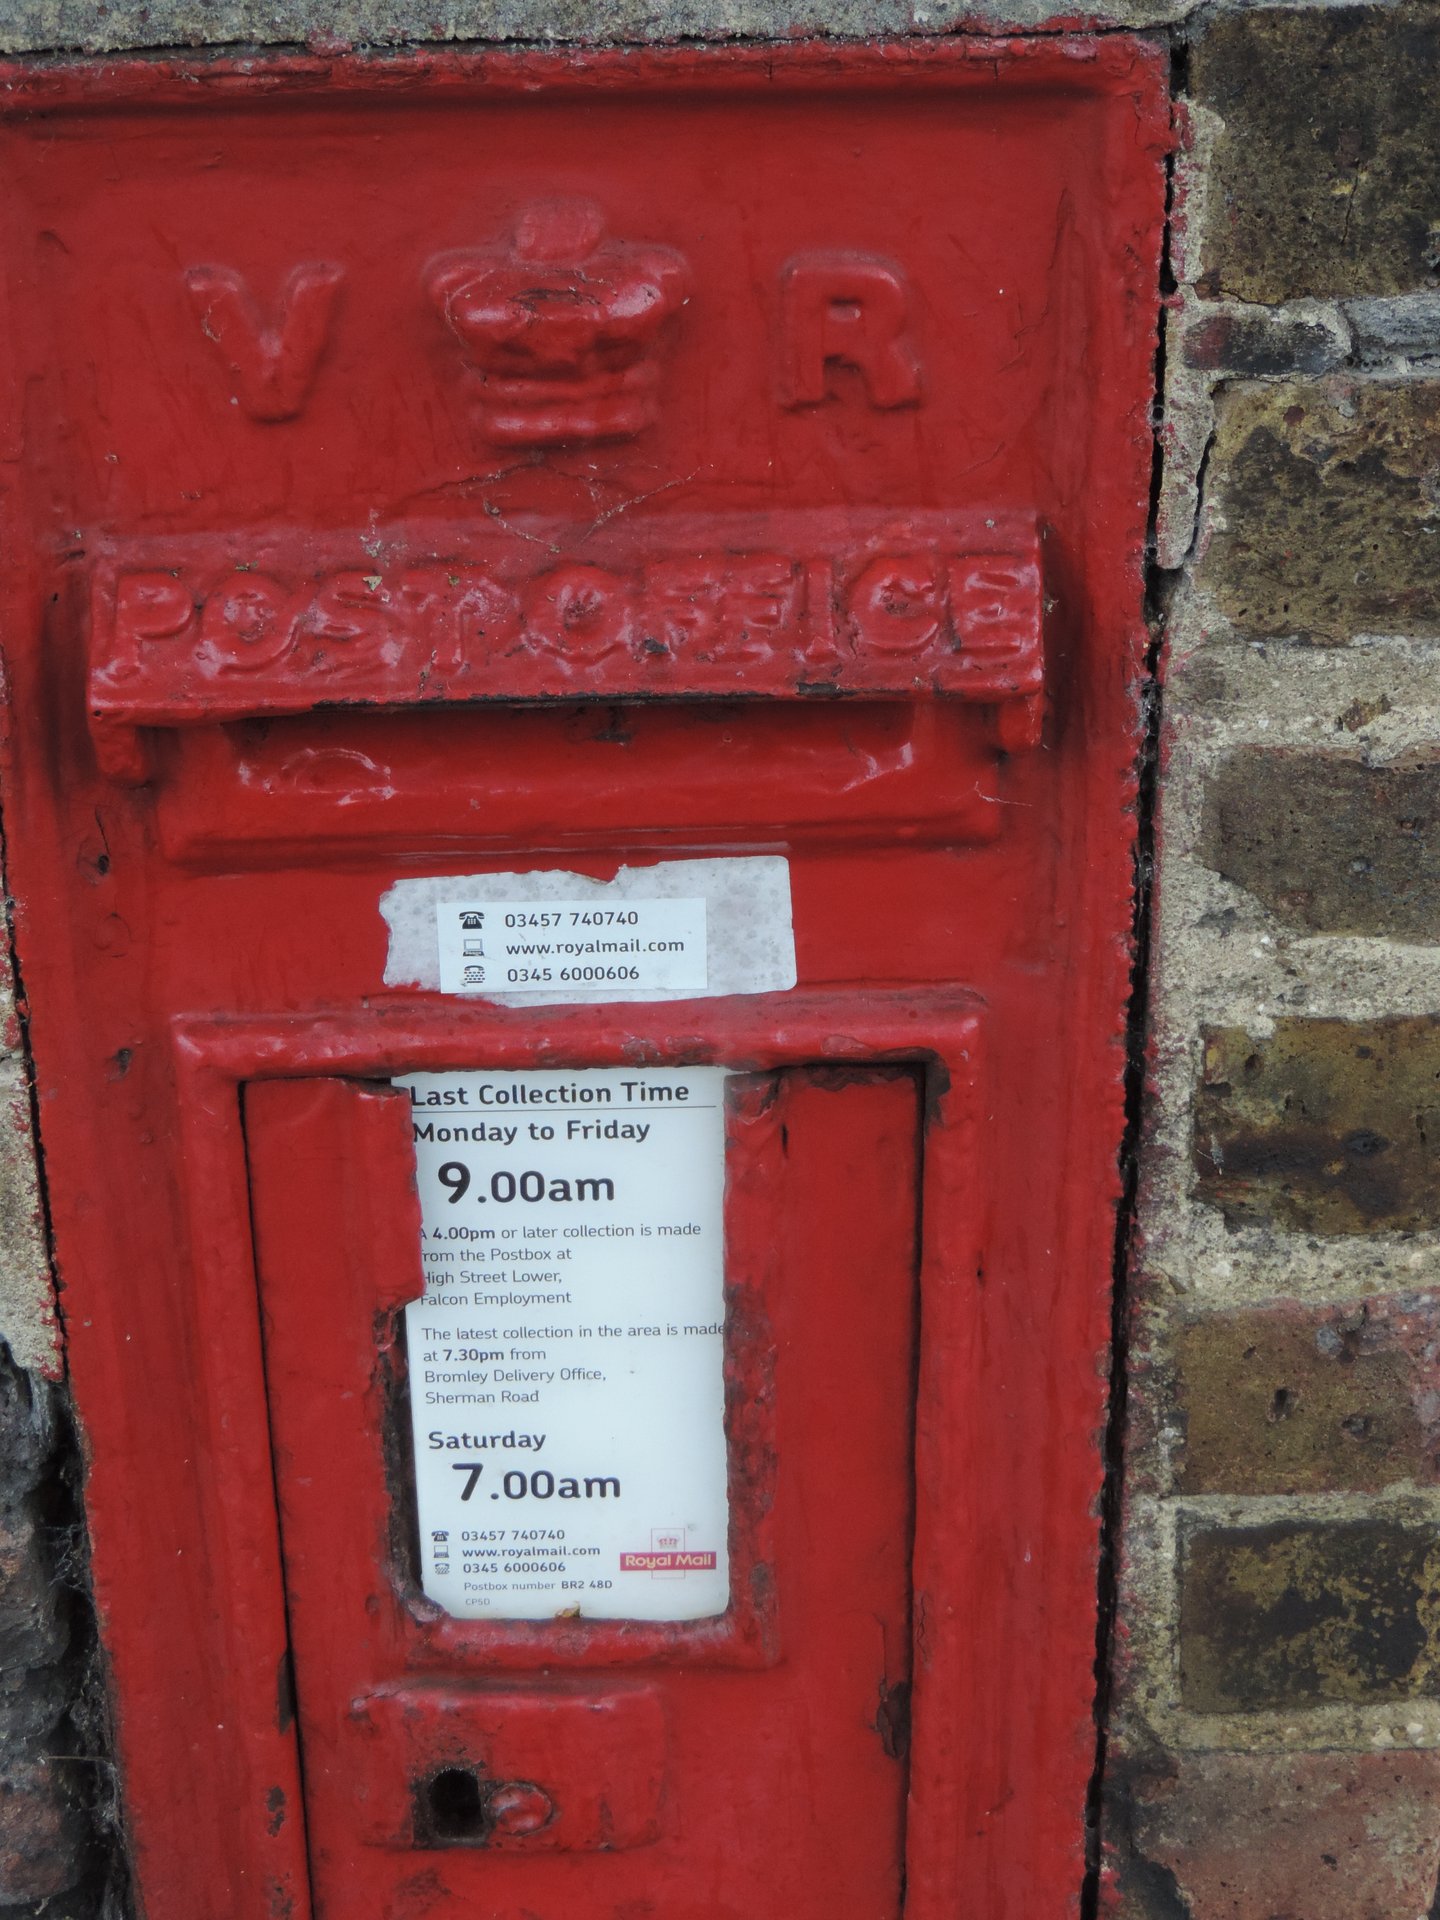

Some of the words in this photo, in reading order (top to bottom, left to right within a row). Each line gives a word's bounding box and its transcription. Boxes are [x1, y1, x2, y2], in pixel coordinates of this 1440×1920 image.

[184, 262, 346, 423] V
[779, 249, 921, 412] R
[504, 913, 561, 928] 03457
[569, 911, 639, 927] 740740
[505, 938, 685, 957] www.royalmail.com
[507, 968, 552, 983] 0345
[560, 966, 640, 981] 6000606
[410, 1085, 469, 1106] Last
[479, 1083, 612, 1105] Collection
[620, 1082, 690, 1102] Time
[412, 1121, 518, 1146] Monday
[528, 1122, 554, 1141] to
[567, 1119, 650, 1143] Friday
[438, 1161, 615, 1204] 9.00am
[432, 1226, 495, 1242] 4.00pm
[501, 1228, 518, 1239] or
[522, 1226, 558, 1239] later
[563, 1224, 635, 1238] collection
[640, 1223, 652, 1237] is
[657, 1222, 702, 1236] made
[460, 1248, 485, 1262] the
[490, 1247, 551, 1261] Postbox
[556, 1248, 572, 1260] at
[460, 1270, 507, 1284] Street
[512, 1269, 562, 1284] Lower,
[420, 1293, 468, 1306] Falcon
[474, 1291, 572, 1307] Employment
[422, 1327, 451, 1341] The
[456, 1326, 498, 1340] latest
[503, 1325, 573, 1339] collection
[578, 1324, 593, 1338] in
[598, 1324, 623, 1337] the
[628, 1326, 661, 1336] area
[666, 1323, 678, 1336] is
[683, 1323, 724, 1335] made
[423, 1351, 439, 1363] at
[442, 1347, 505, 1363] 7.30pm
[510, 1347, 547, 1361] from
[424, 1369, 488, 1385] Bromley
[493, 1368, 555, 1383] Delivery
[560, 1367, 607, 1381] Office,
[425, 1391, 496, 1405] Sherman
[501, 1389, 540, 1403] Road
[428, 1430, 546, 1452] Saturday
[451, 1462, 621, 1501] 7.00am
[461, 1530, 505, 1542] 03457
[511, 1529, 565, 1540] 740740
[462, 1545, 601, 1559] www.royalmail.com
[463, 1562, 498, 1574] 0345
[504, 1562, 566, 1573] 6000606
[625, 1554, 671, 1569] Royal
[675, 1553, 712, 1566] Mail
[464, 1581, 508, 1592] Postbox
[512, 1580, 556, 1591] number
[561, 1580, 584, 1590] BR2
[589, 1579, 613, 1590] 48D
